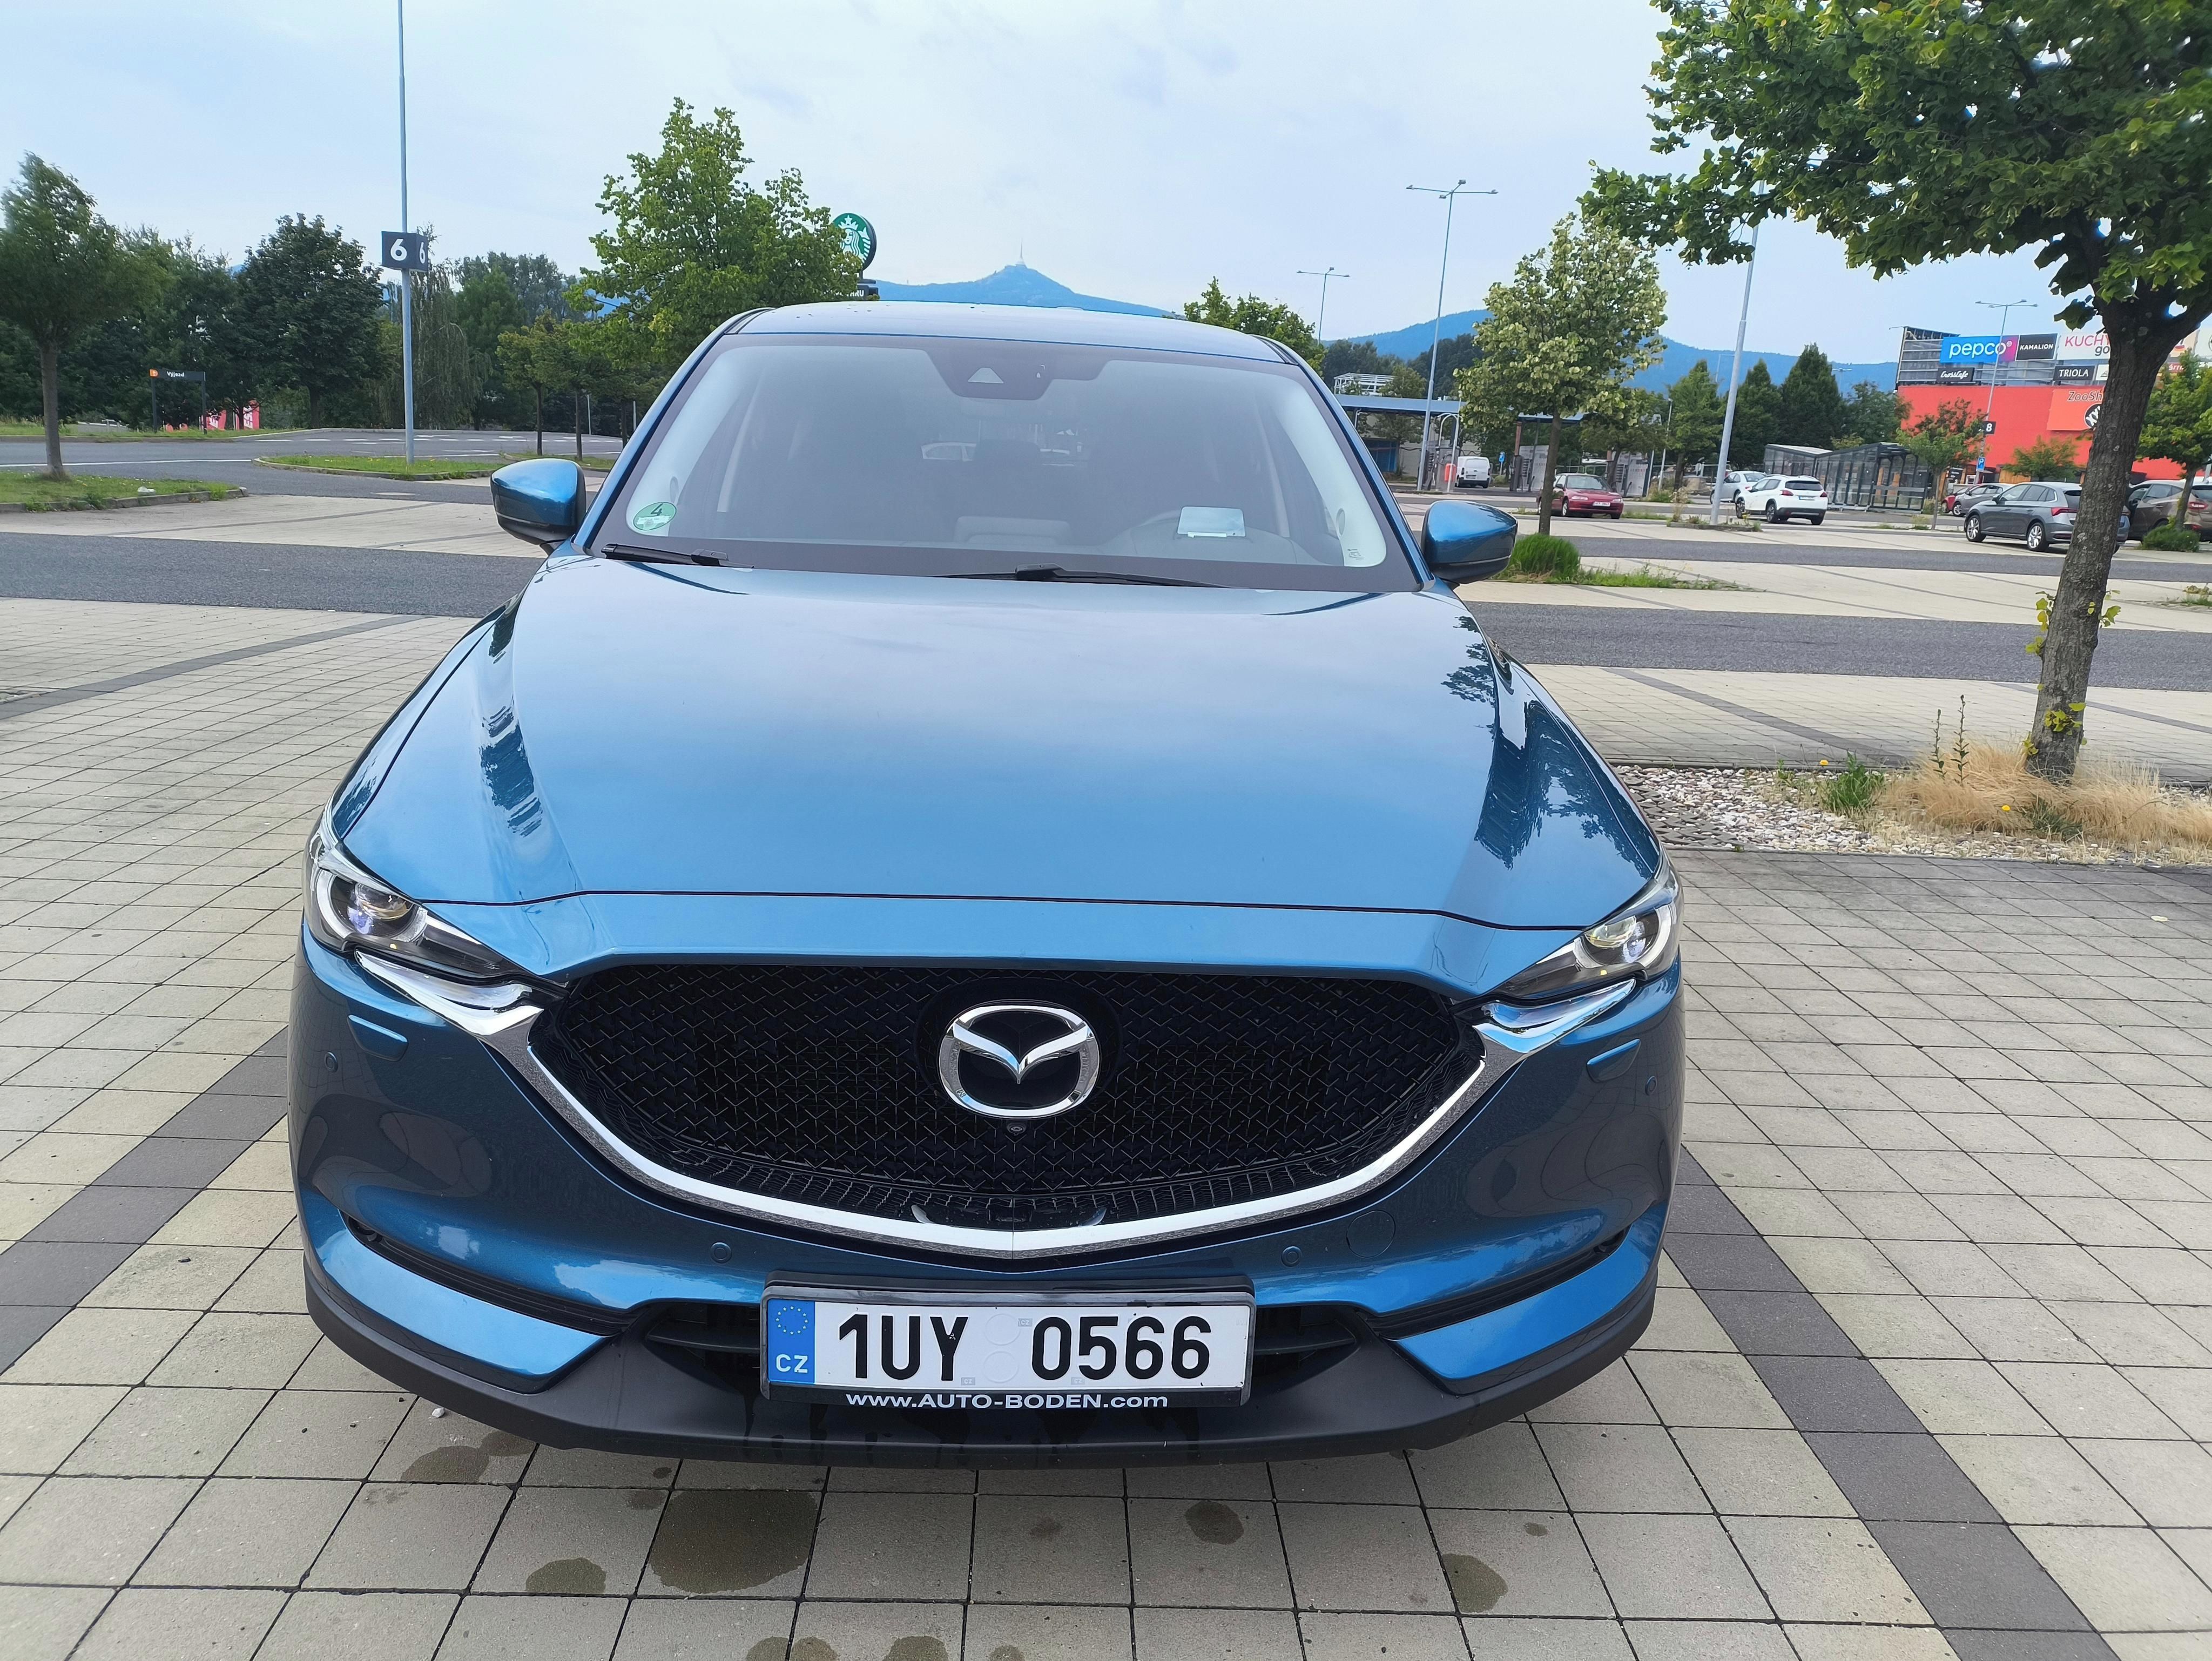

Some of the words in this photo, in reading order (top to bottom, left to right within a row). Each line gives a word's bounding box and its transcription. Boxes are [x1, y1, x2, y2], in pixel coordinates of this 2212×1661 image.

[390, 238, 407, 261] 6
[419, 241, 426, 264] 6
[1948, 342, 2006, 359] pepco
[2059, 369, 2089, 377] TRIOLA
[1986, 423, 1992, 432] 8
[650, 503, 663, 516] 4
[838, 1313, 969, 1381] 1UY
[1031, 1315, 1211, 1381] 0566
[775, 1354, 808, 1373] CZ
[846, 1393, 1168, 1409] www.AUTO-BODEN.com
